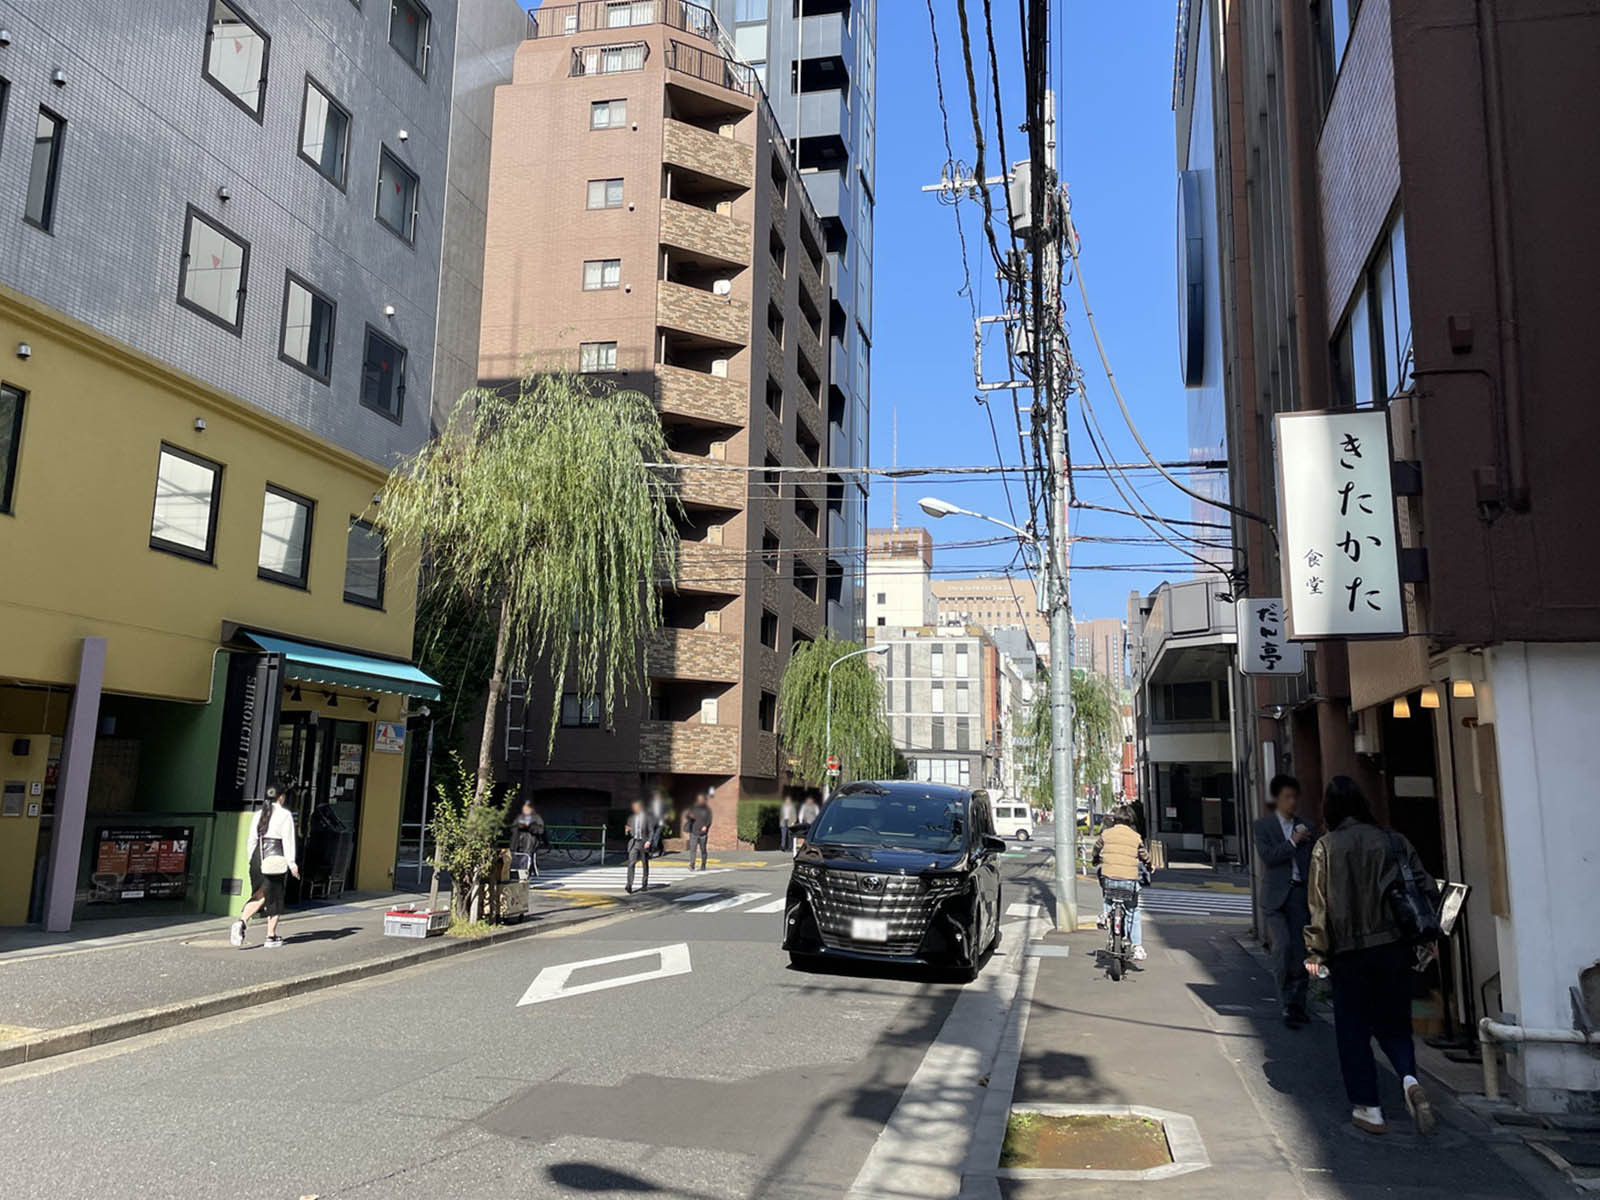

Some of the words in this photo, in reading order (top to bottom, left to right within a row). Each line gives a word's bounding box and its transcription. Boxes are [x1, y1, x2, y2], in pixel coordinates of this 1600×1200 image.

[1336, 433, 1382, 612] きたかた
[1304, 548, 1325, 595] 食堂
[239, 675, 257, 752] SHIROICHI
[235, 756, 249, 790] BLD.
